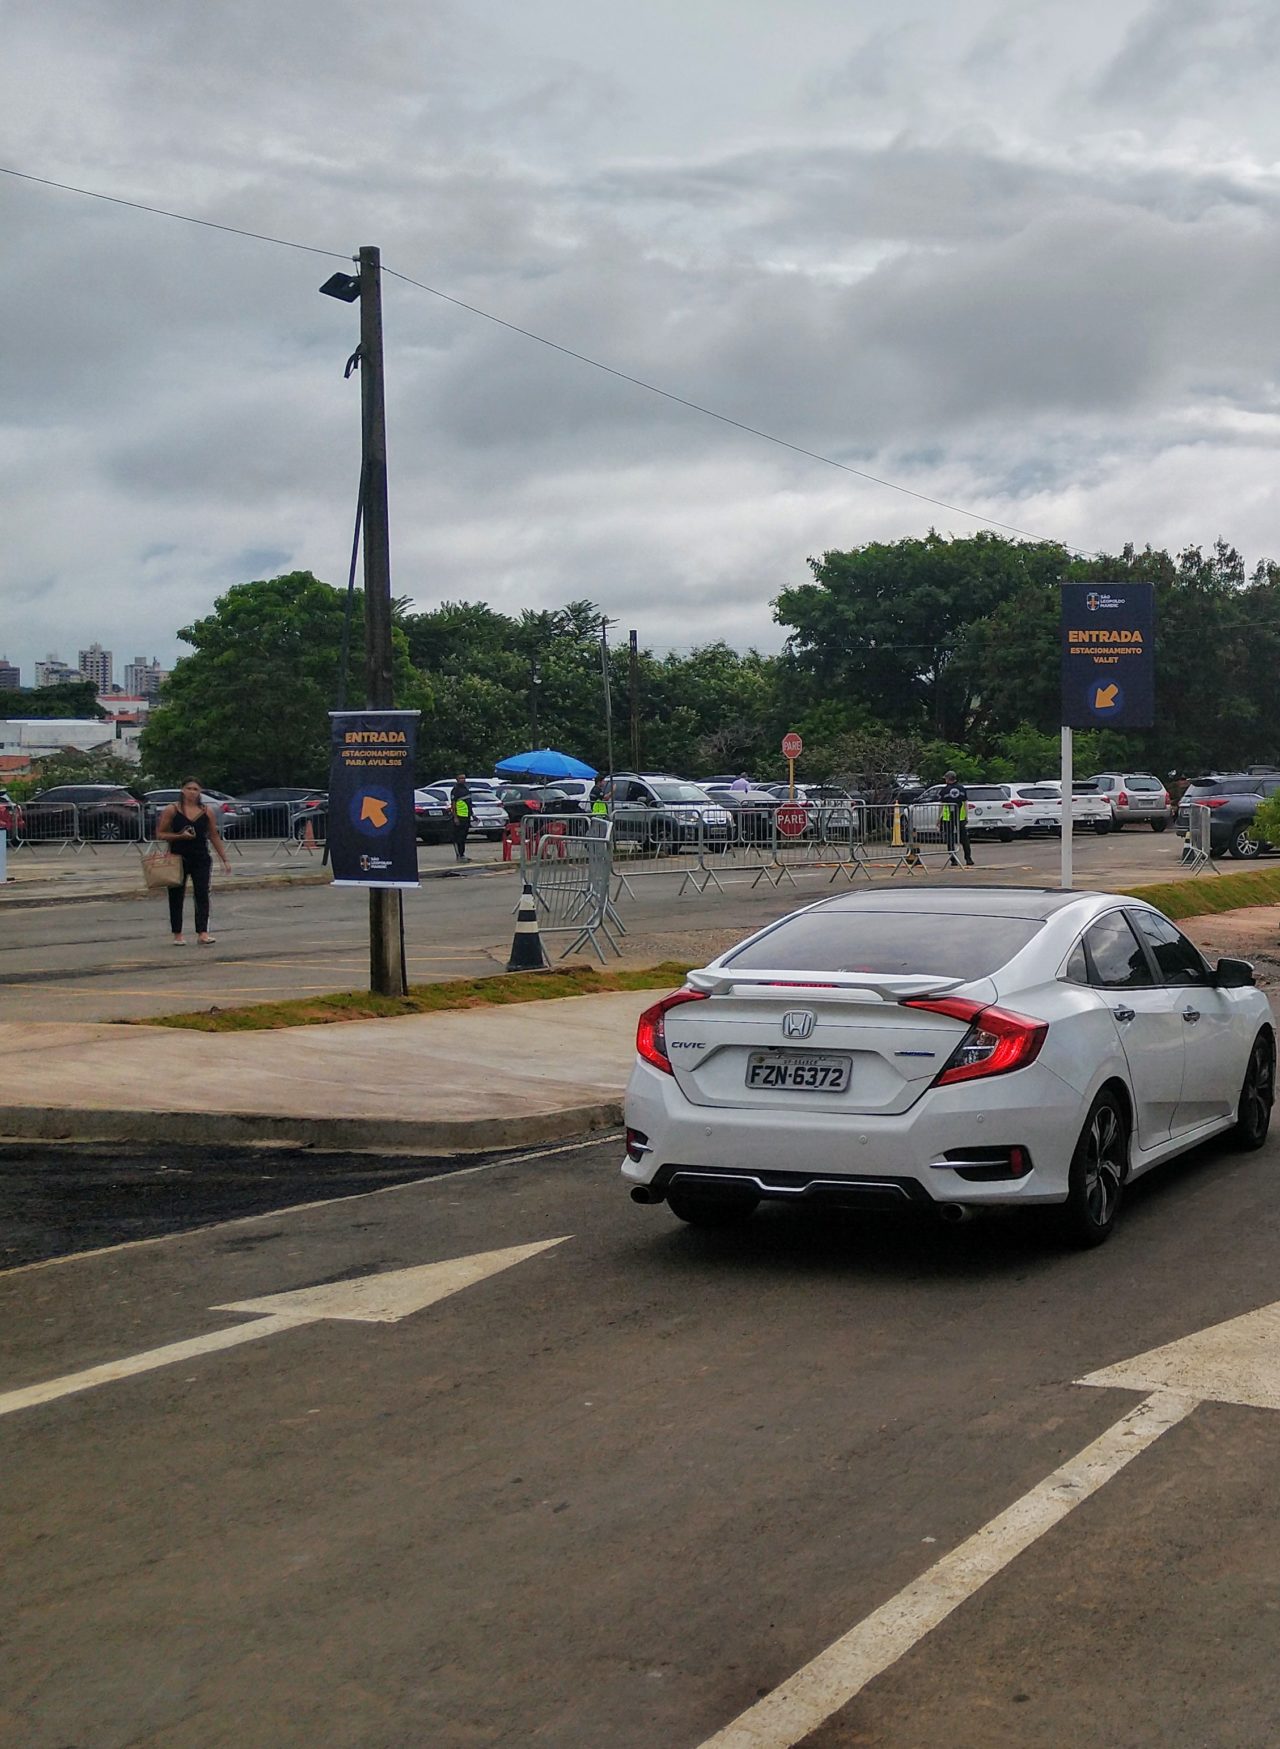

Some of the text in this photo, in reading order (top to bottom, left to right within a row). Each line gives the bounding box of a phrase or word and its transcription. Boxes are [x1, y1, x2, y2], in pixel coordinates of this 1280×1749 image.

[1068, 630, 1143, 643] ENTRADA
[345, 731, 406, 743] ENTRADA
[784, 742, 801, 750] PARE
[777, 814, 805, 824] PARE
[671, 1041, 706, 1050] CIVIC
